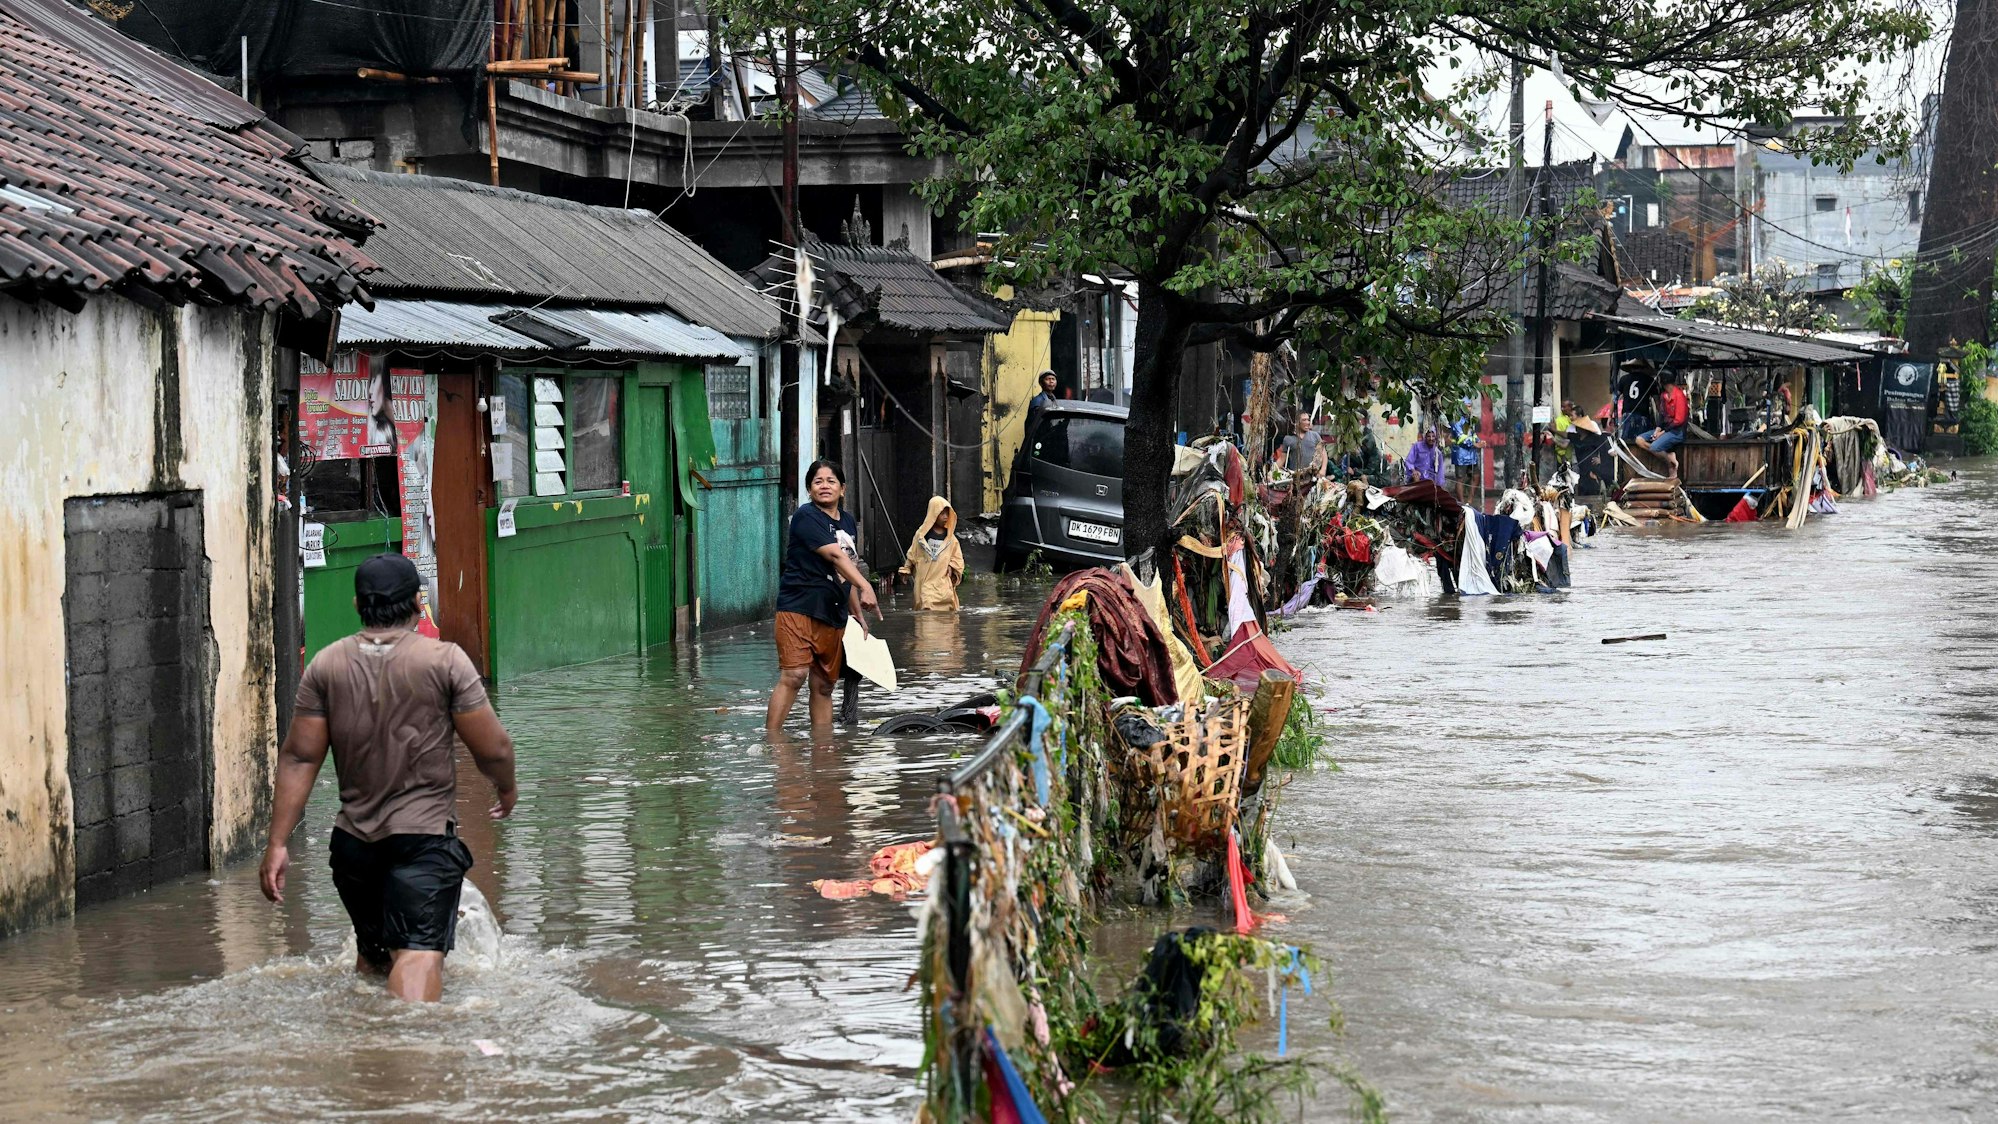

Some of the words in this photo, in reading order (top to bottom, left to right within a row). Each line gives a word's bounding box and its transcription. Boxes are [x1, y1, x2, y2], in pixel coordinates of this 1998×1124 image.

[335, 379, 368, 402] SALON
[1629, 380, 1639, 399] 6
[392, 399, 425, 422] SALON
[1071, 522, 1082, 532] DK
[1083, 524, 1103, 535] 1679
[1103, 527, 1120, 538] FBN
